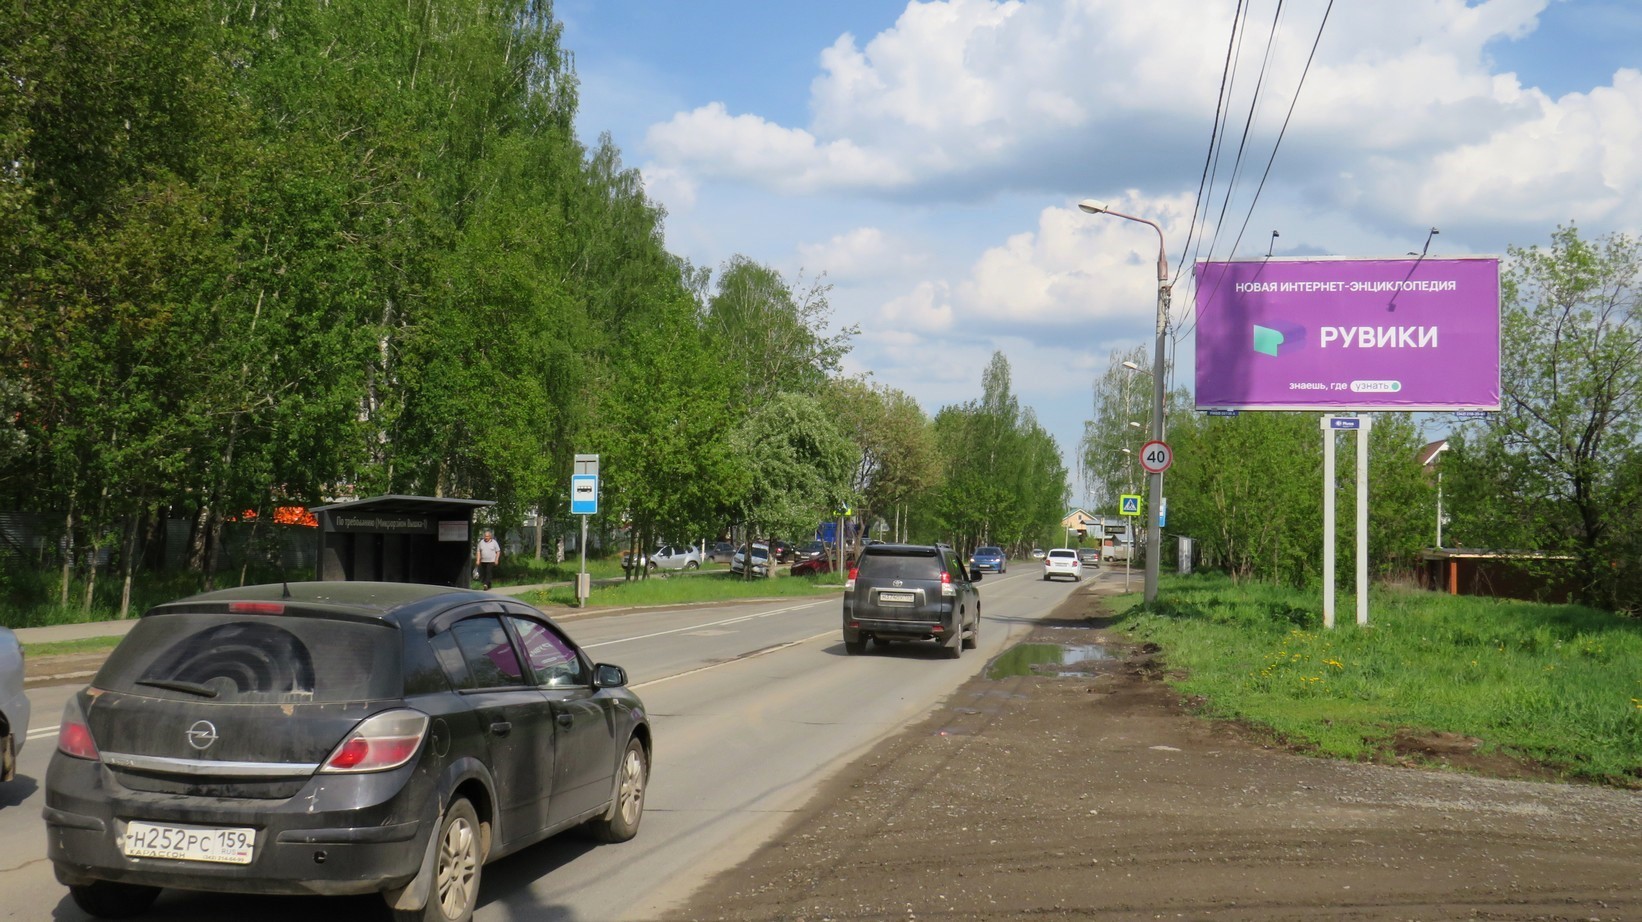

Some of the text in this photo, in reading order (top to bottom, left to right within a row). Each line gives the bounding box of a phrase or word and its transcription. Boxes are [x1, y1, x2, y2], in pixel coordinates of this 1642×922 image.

[1236, 281, 1456, 293] НОВАЯ ИНТЕРНЕТ-ЭНЦИКЛОПЕДИЯ
[1320, 326, 1438, 348] РУВИКИ
[1289, 382, 1389, 392] знаешь, где узнать
[1147, 450, 1165, 463] 40
[133, 828, 247, 852] Н252РС 159
[221, 848, 236, 856] RUS
